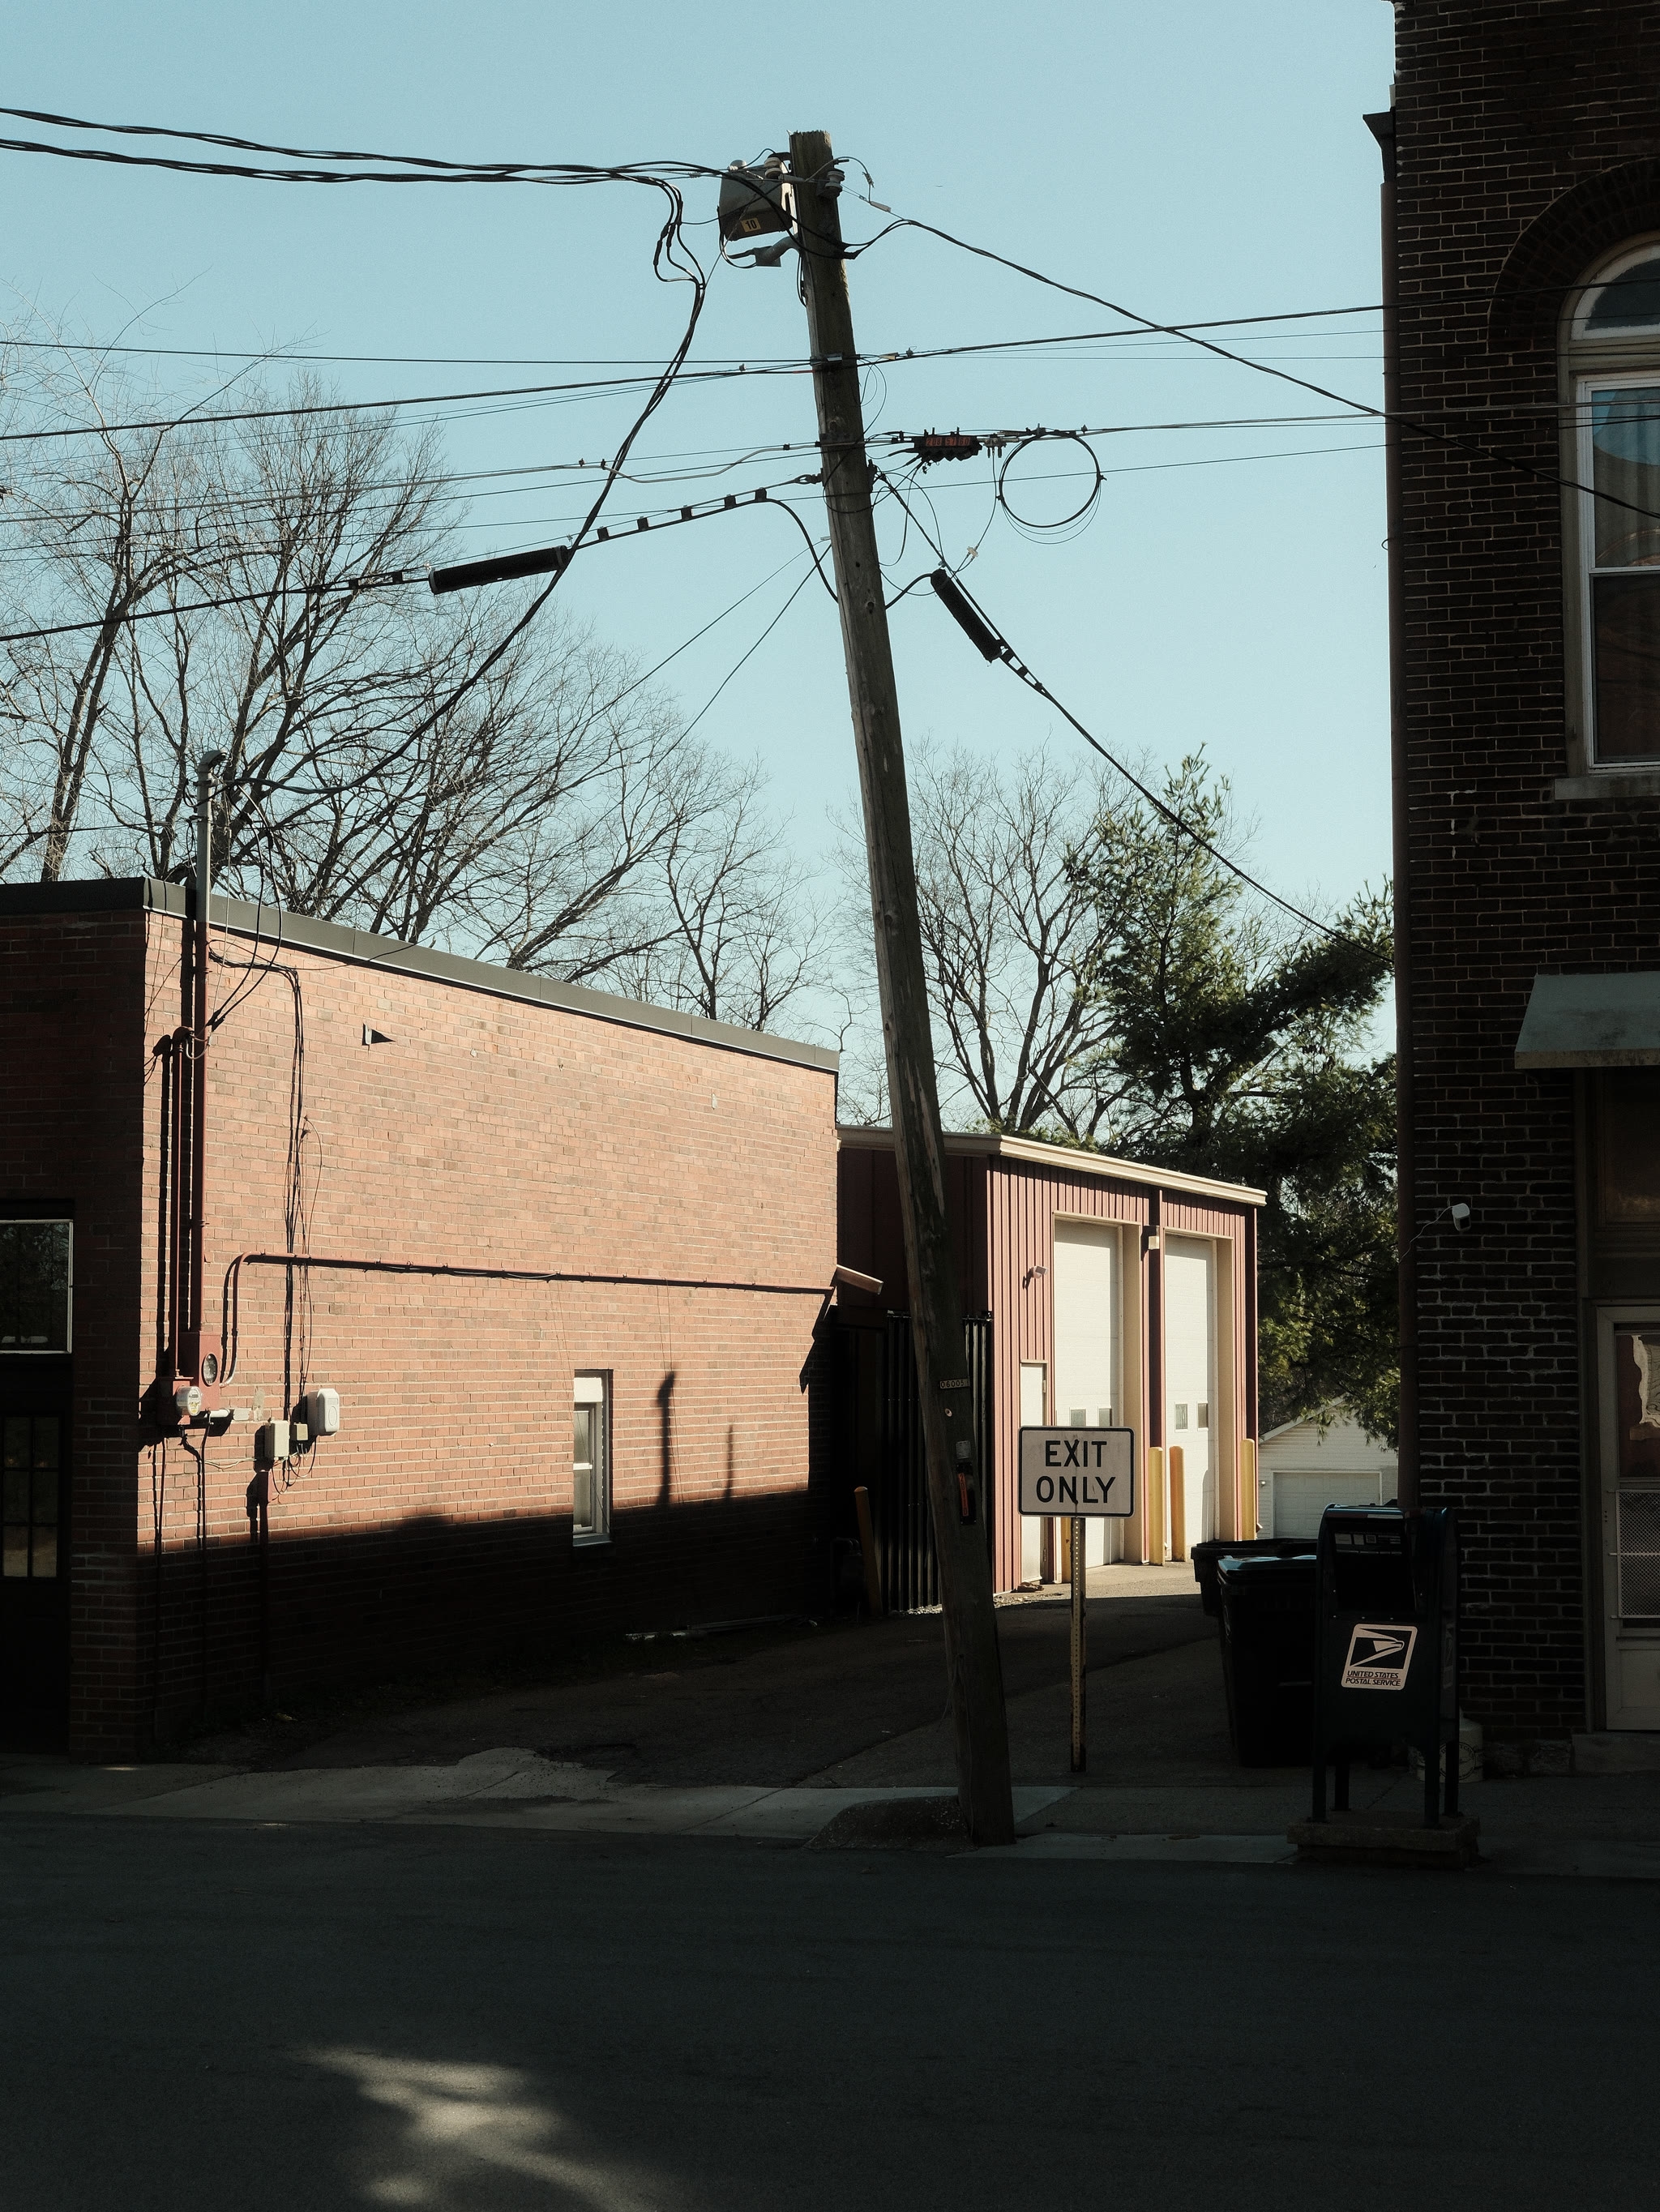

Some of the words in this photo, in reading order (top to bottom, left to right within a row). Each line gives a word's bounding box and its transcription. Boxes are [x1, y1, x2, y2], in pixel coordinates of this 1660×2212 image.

[745, 220, 758, 230] 10
[1046, 1440, 1107, 1467] EXIT
[1036, 1475, 1116, 1504] ONLY
